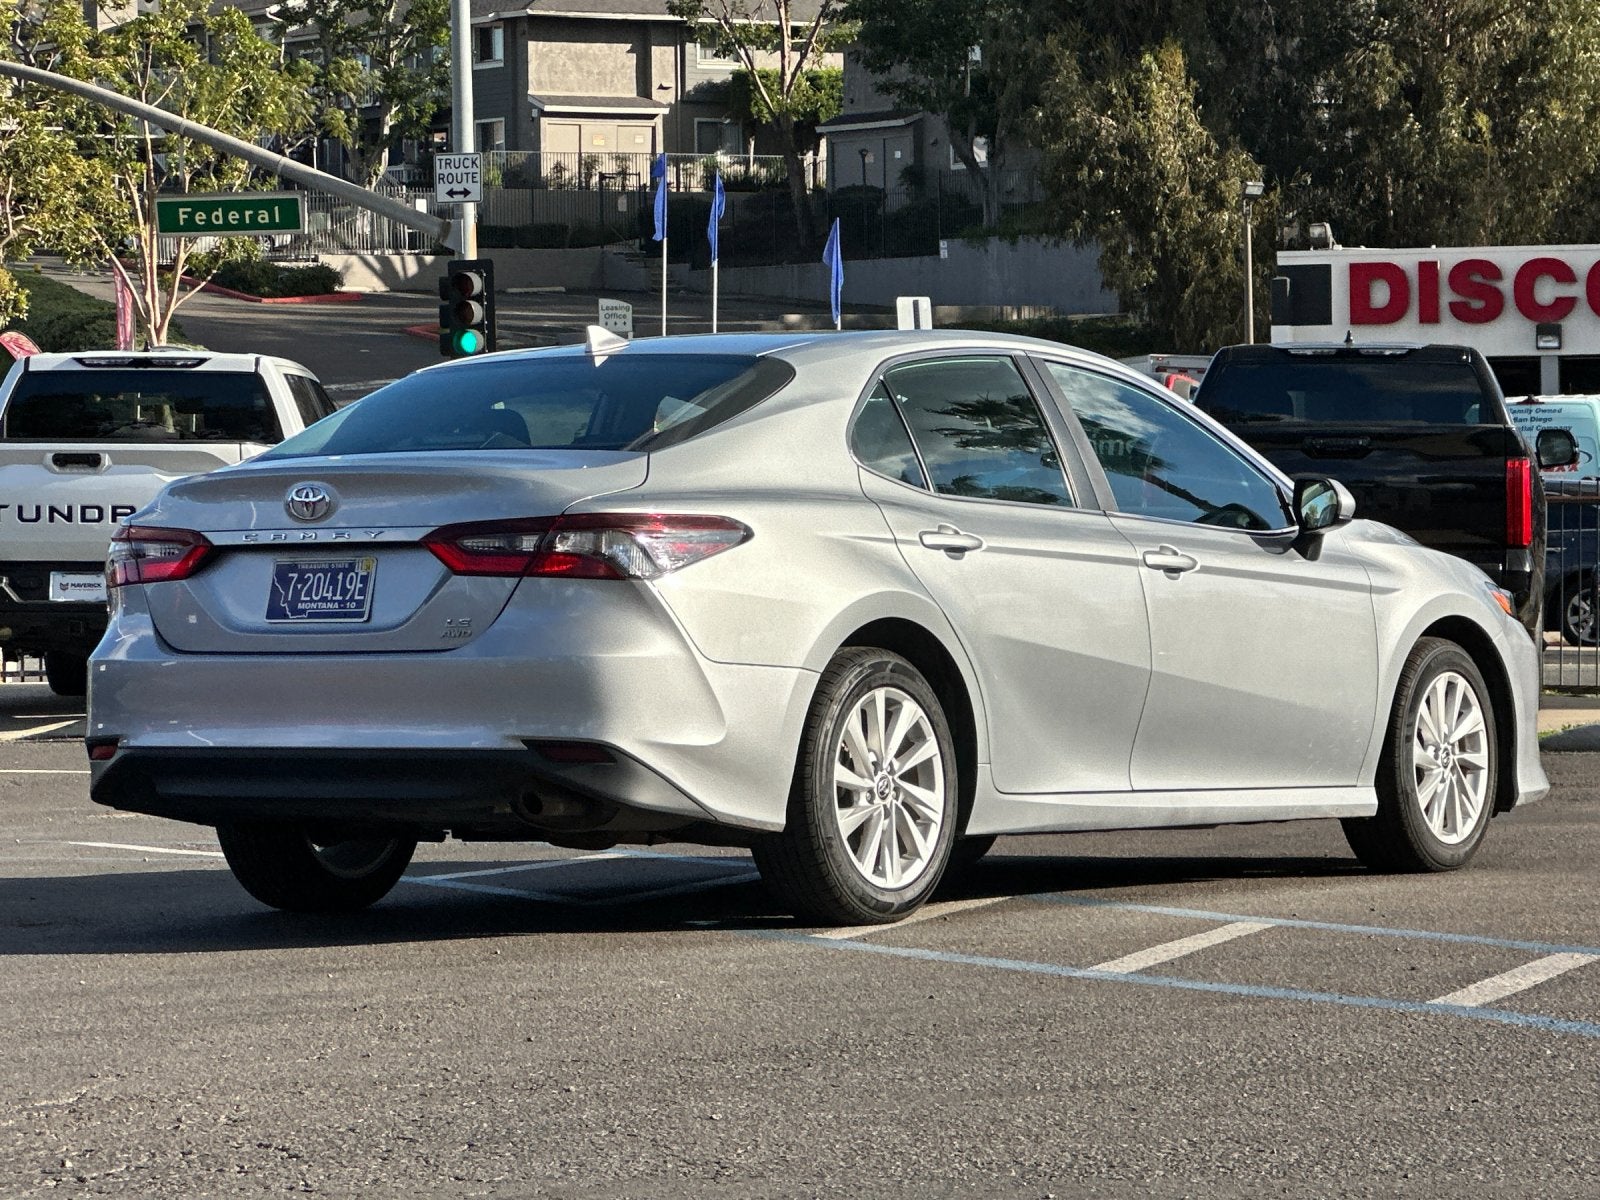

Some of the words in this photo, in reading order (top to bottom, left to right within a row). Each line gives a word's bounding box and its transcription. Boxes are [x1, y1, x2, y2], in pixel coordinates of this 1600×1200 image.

[437, 157, 479, 169] TRUCK
[438, 172, 479, 184] ROUTE
[178, 205, 280, 226] Federal
[1349, 257, 1600, 325] DISC
[601, 304, 630, 312] Leasing
[243, 531, 384, 541] CAMRY
[440, 630, 472, 638] AWD
